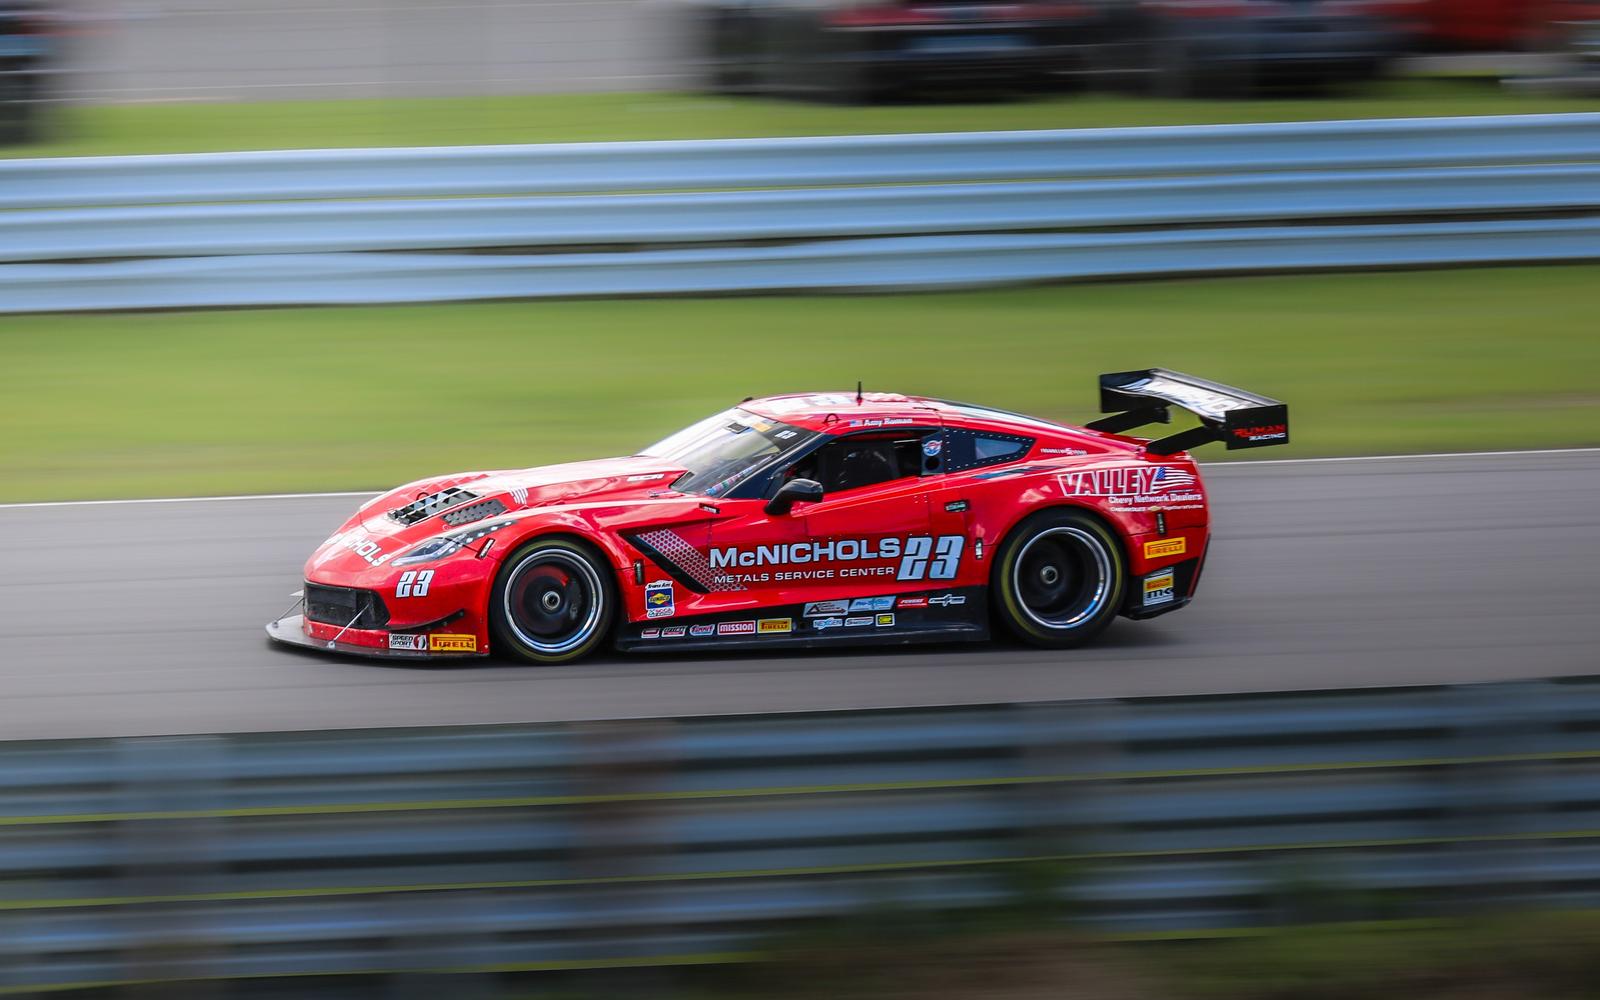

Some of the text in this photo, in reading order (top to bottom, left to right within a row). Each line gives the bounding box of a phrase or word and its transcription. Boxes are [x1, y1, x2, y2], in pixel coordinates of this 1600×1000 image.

[864, 419, 882, 427] Amy
[1248, 432, 1286, 441] RACING
[1057, 467, 1160, 497] VALLEY
[1108, 493, 1202, 505] Chevy Network Dealers
[1147, 541, 1183, 555] PIRELLI
[709, 535, 965, 581] McNICHOLS 23
[714, 567, 895, 584] METALS SERVICE CENTER
[395, 569, 435, 598] 23
[720, 623, 754, 633] MISSION
[761, 621, 788, 631] PIRELLI
[432, 637, 474, 649] PIRELLI
